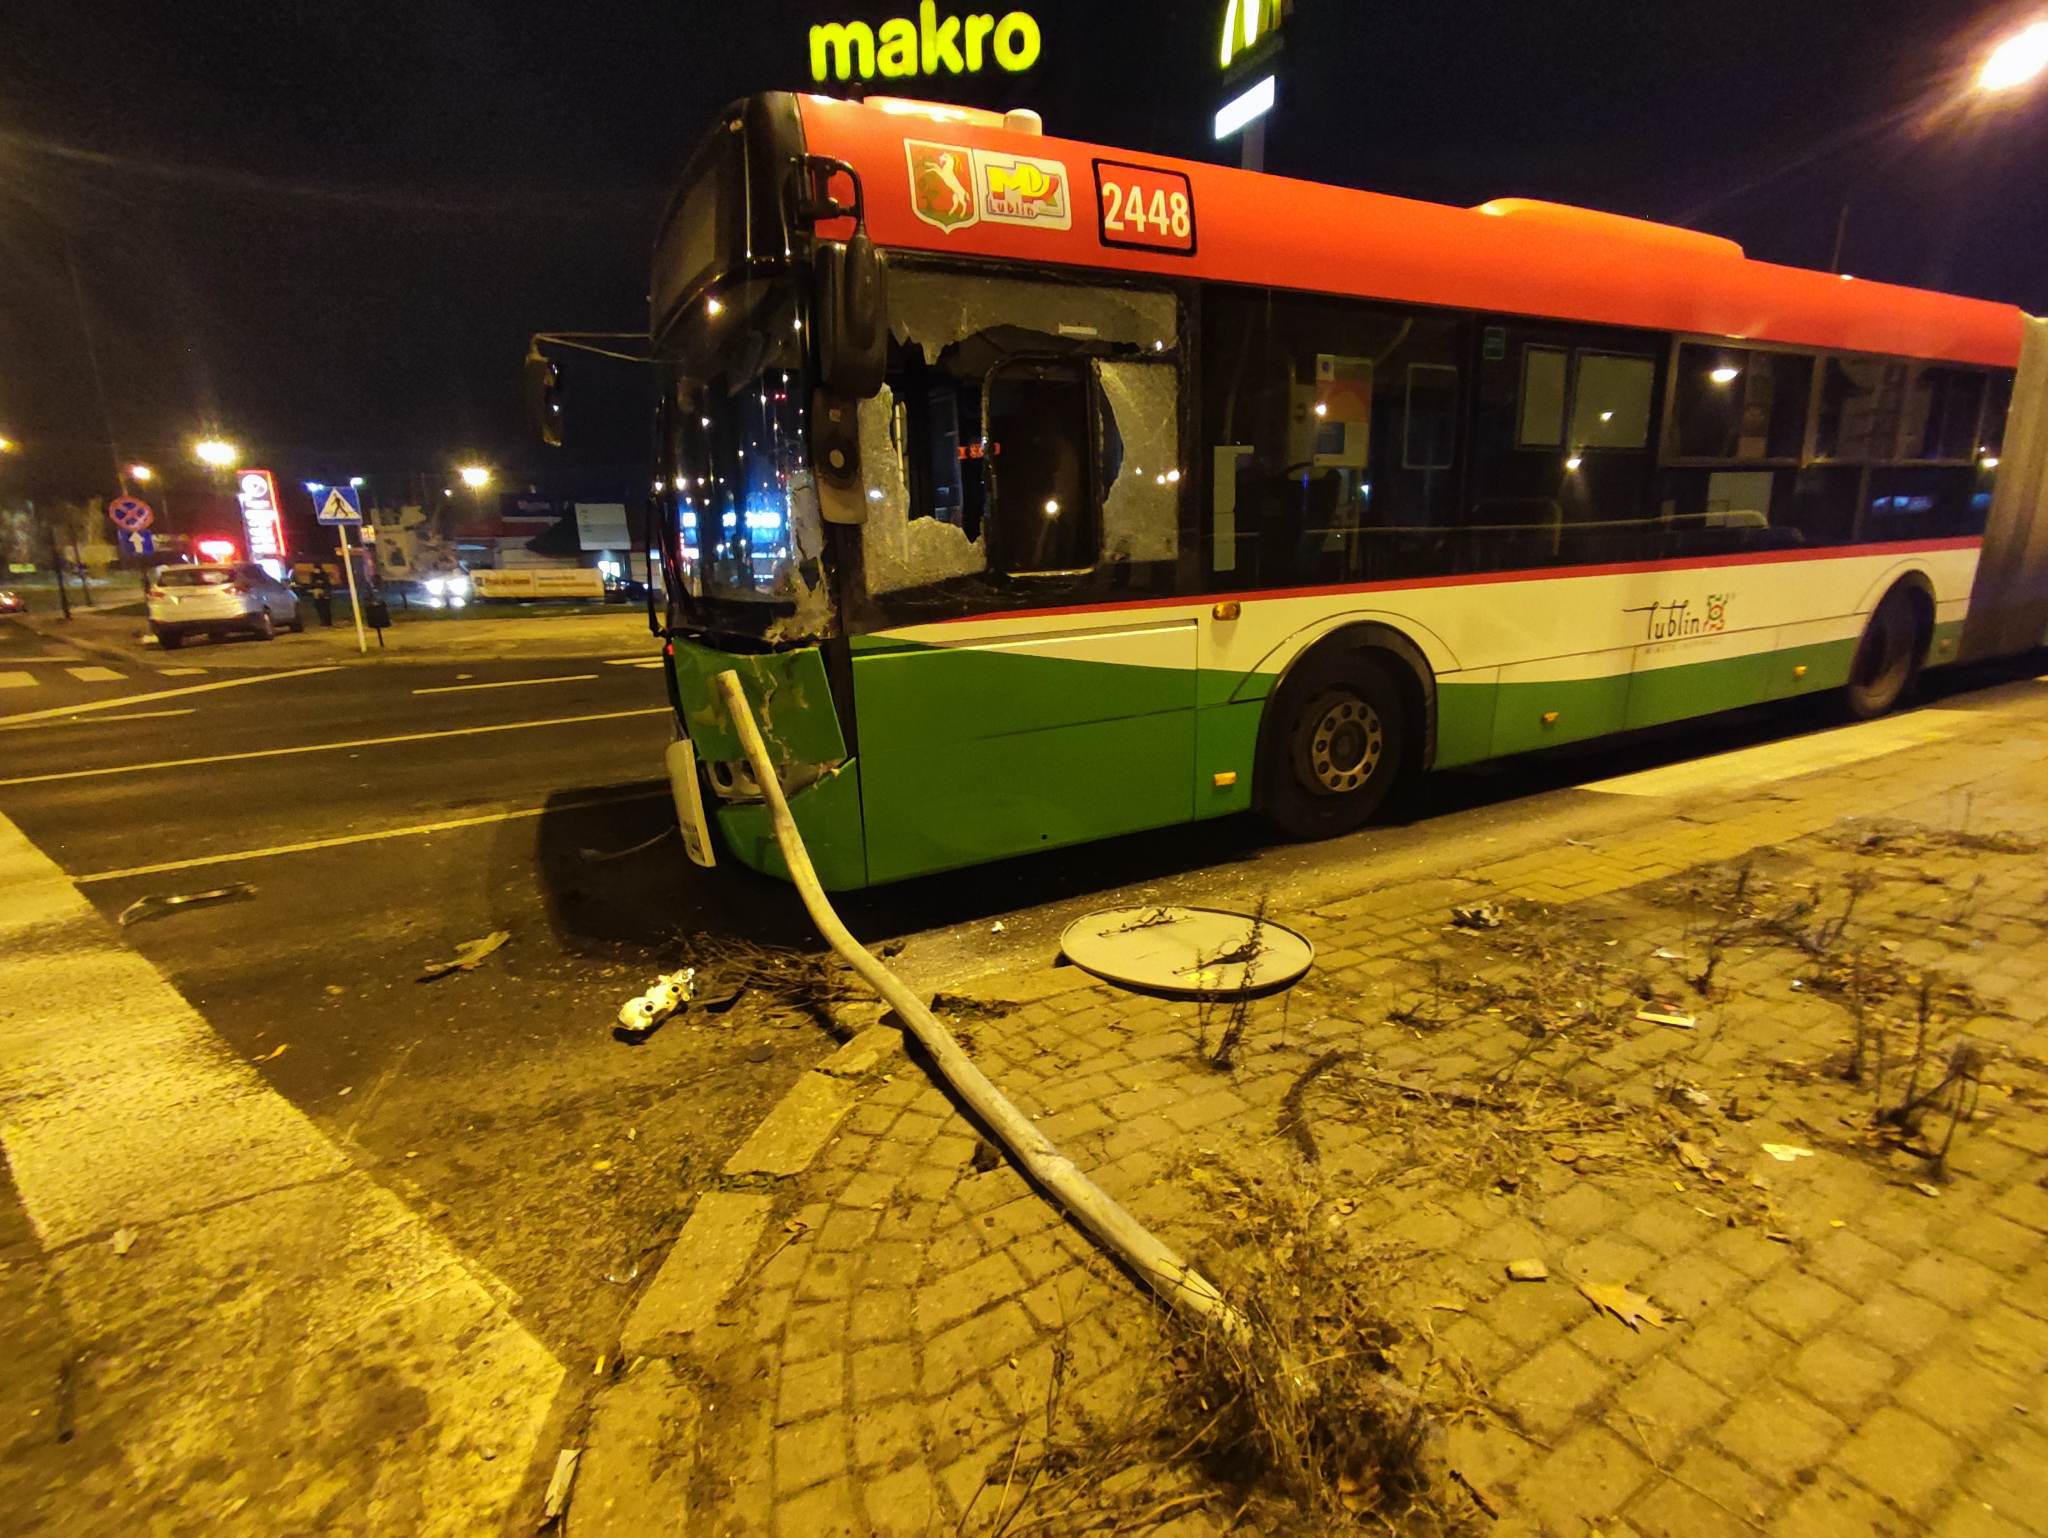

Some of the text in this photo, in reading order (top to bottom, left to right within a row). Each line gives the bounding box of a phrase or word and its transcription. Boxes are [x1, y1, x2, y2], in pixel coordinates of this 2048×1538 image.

[809, 0, 1041, 80] makro
[989, 198, 1035, 217] Lublin
[1102, 181, 1191, 238] 2448
